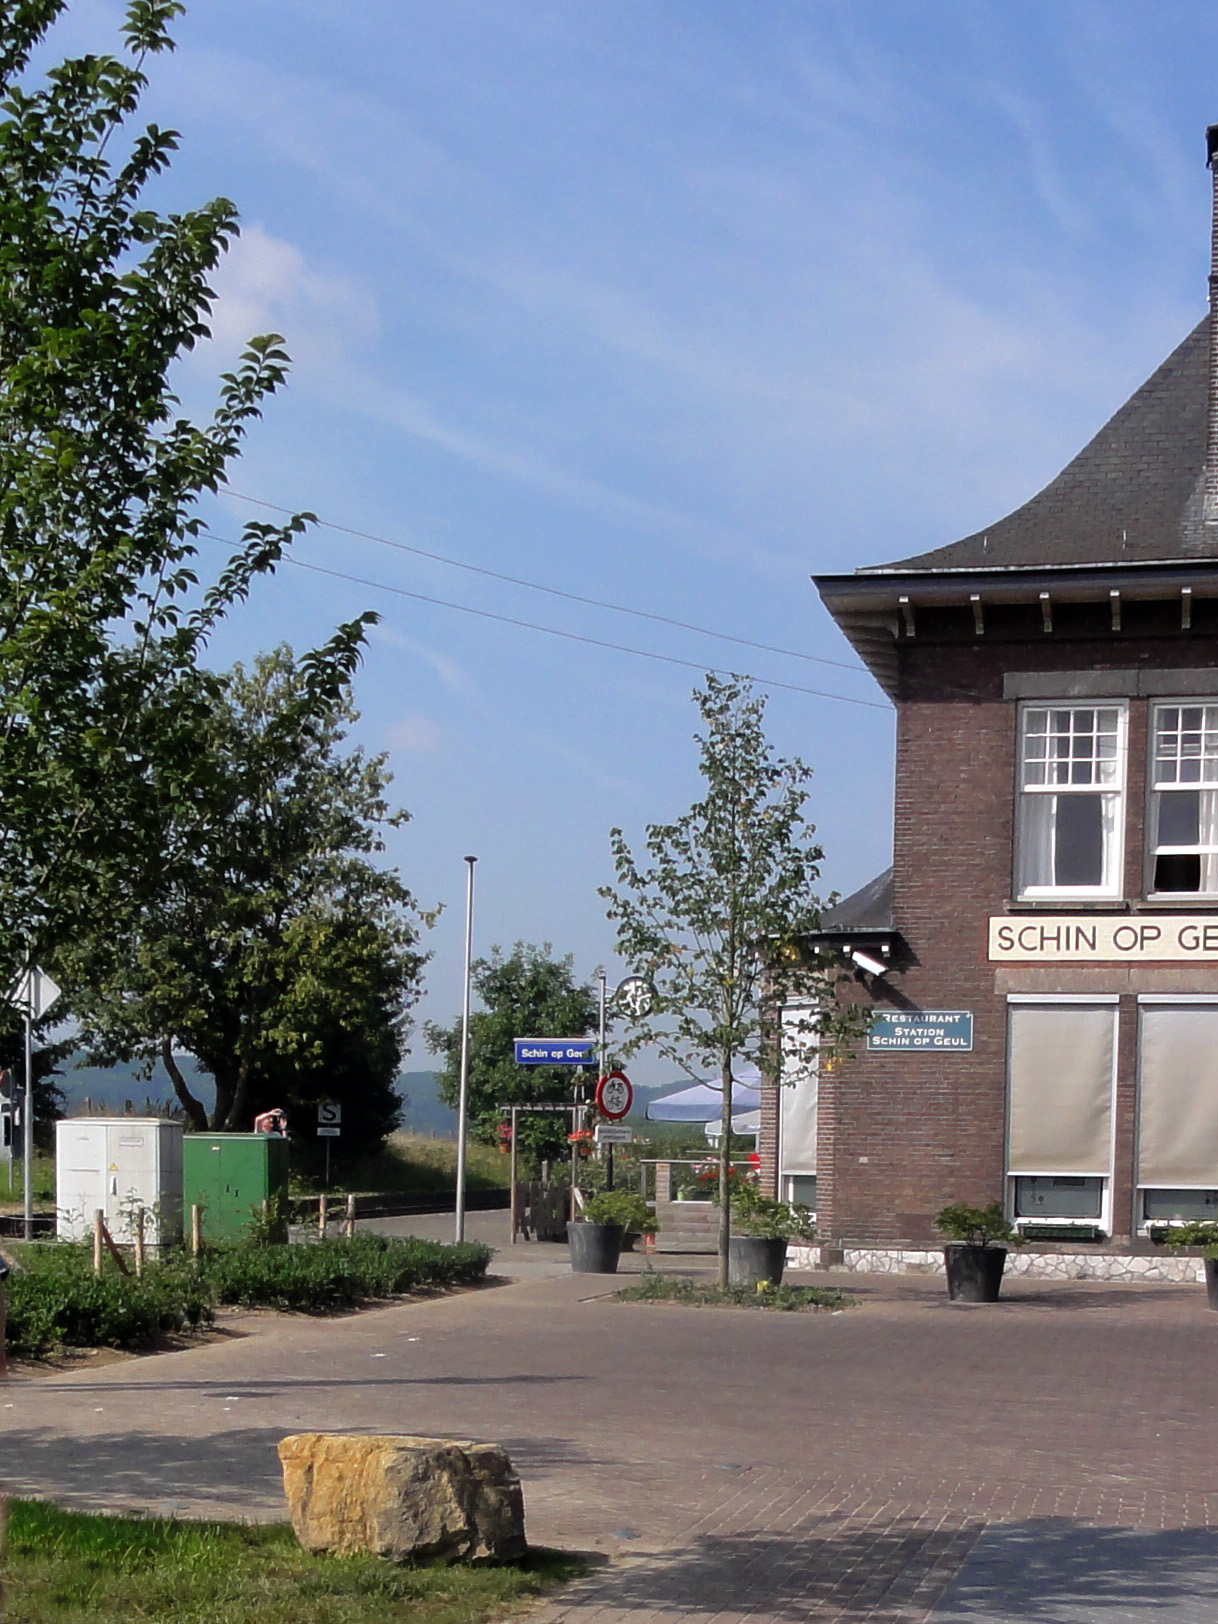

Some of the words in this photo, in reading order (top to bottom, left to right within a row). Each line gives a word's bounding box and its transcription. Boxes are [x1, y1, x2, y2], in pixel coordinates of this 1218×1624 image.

[997, 925, 1097, 951] SCHIN
[1113, 925, 1162, 951] OP
[882, 1014, 960, 1023] RESTAURANT
[894, 1027, 944, 1036] STATION
[872, 1036, 910, 1045] SCHIN
[933, 1036, 968, 1045] GEUL
[521, 1048, 548, 1058] Schin
[322, 1102, 337, 1121] S
